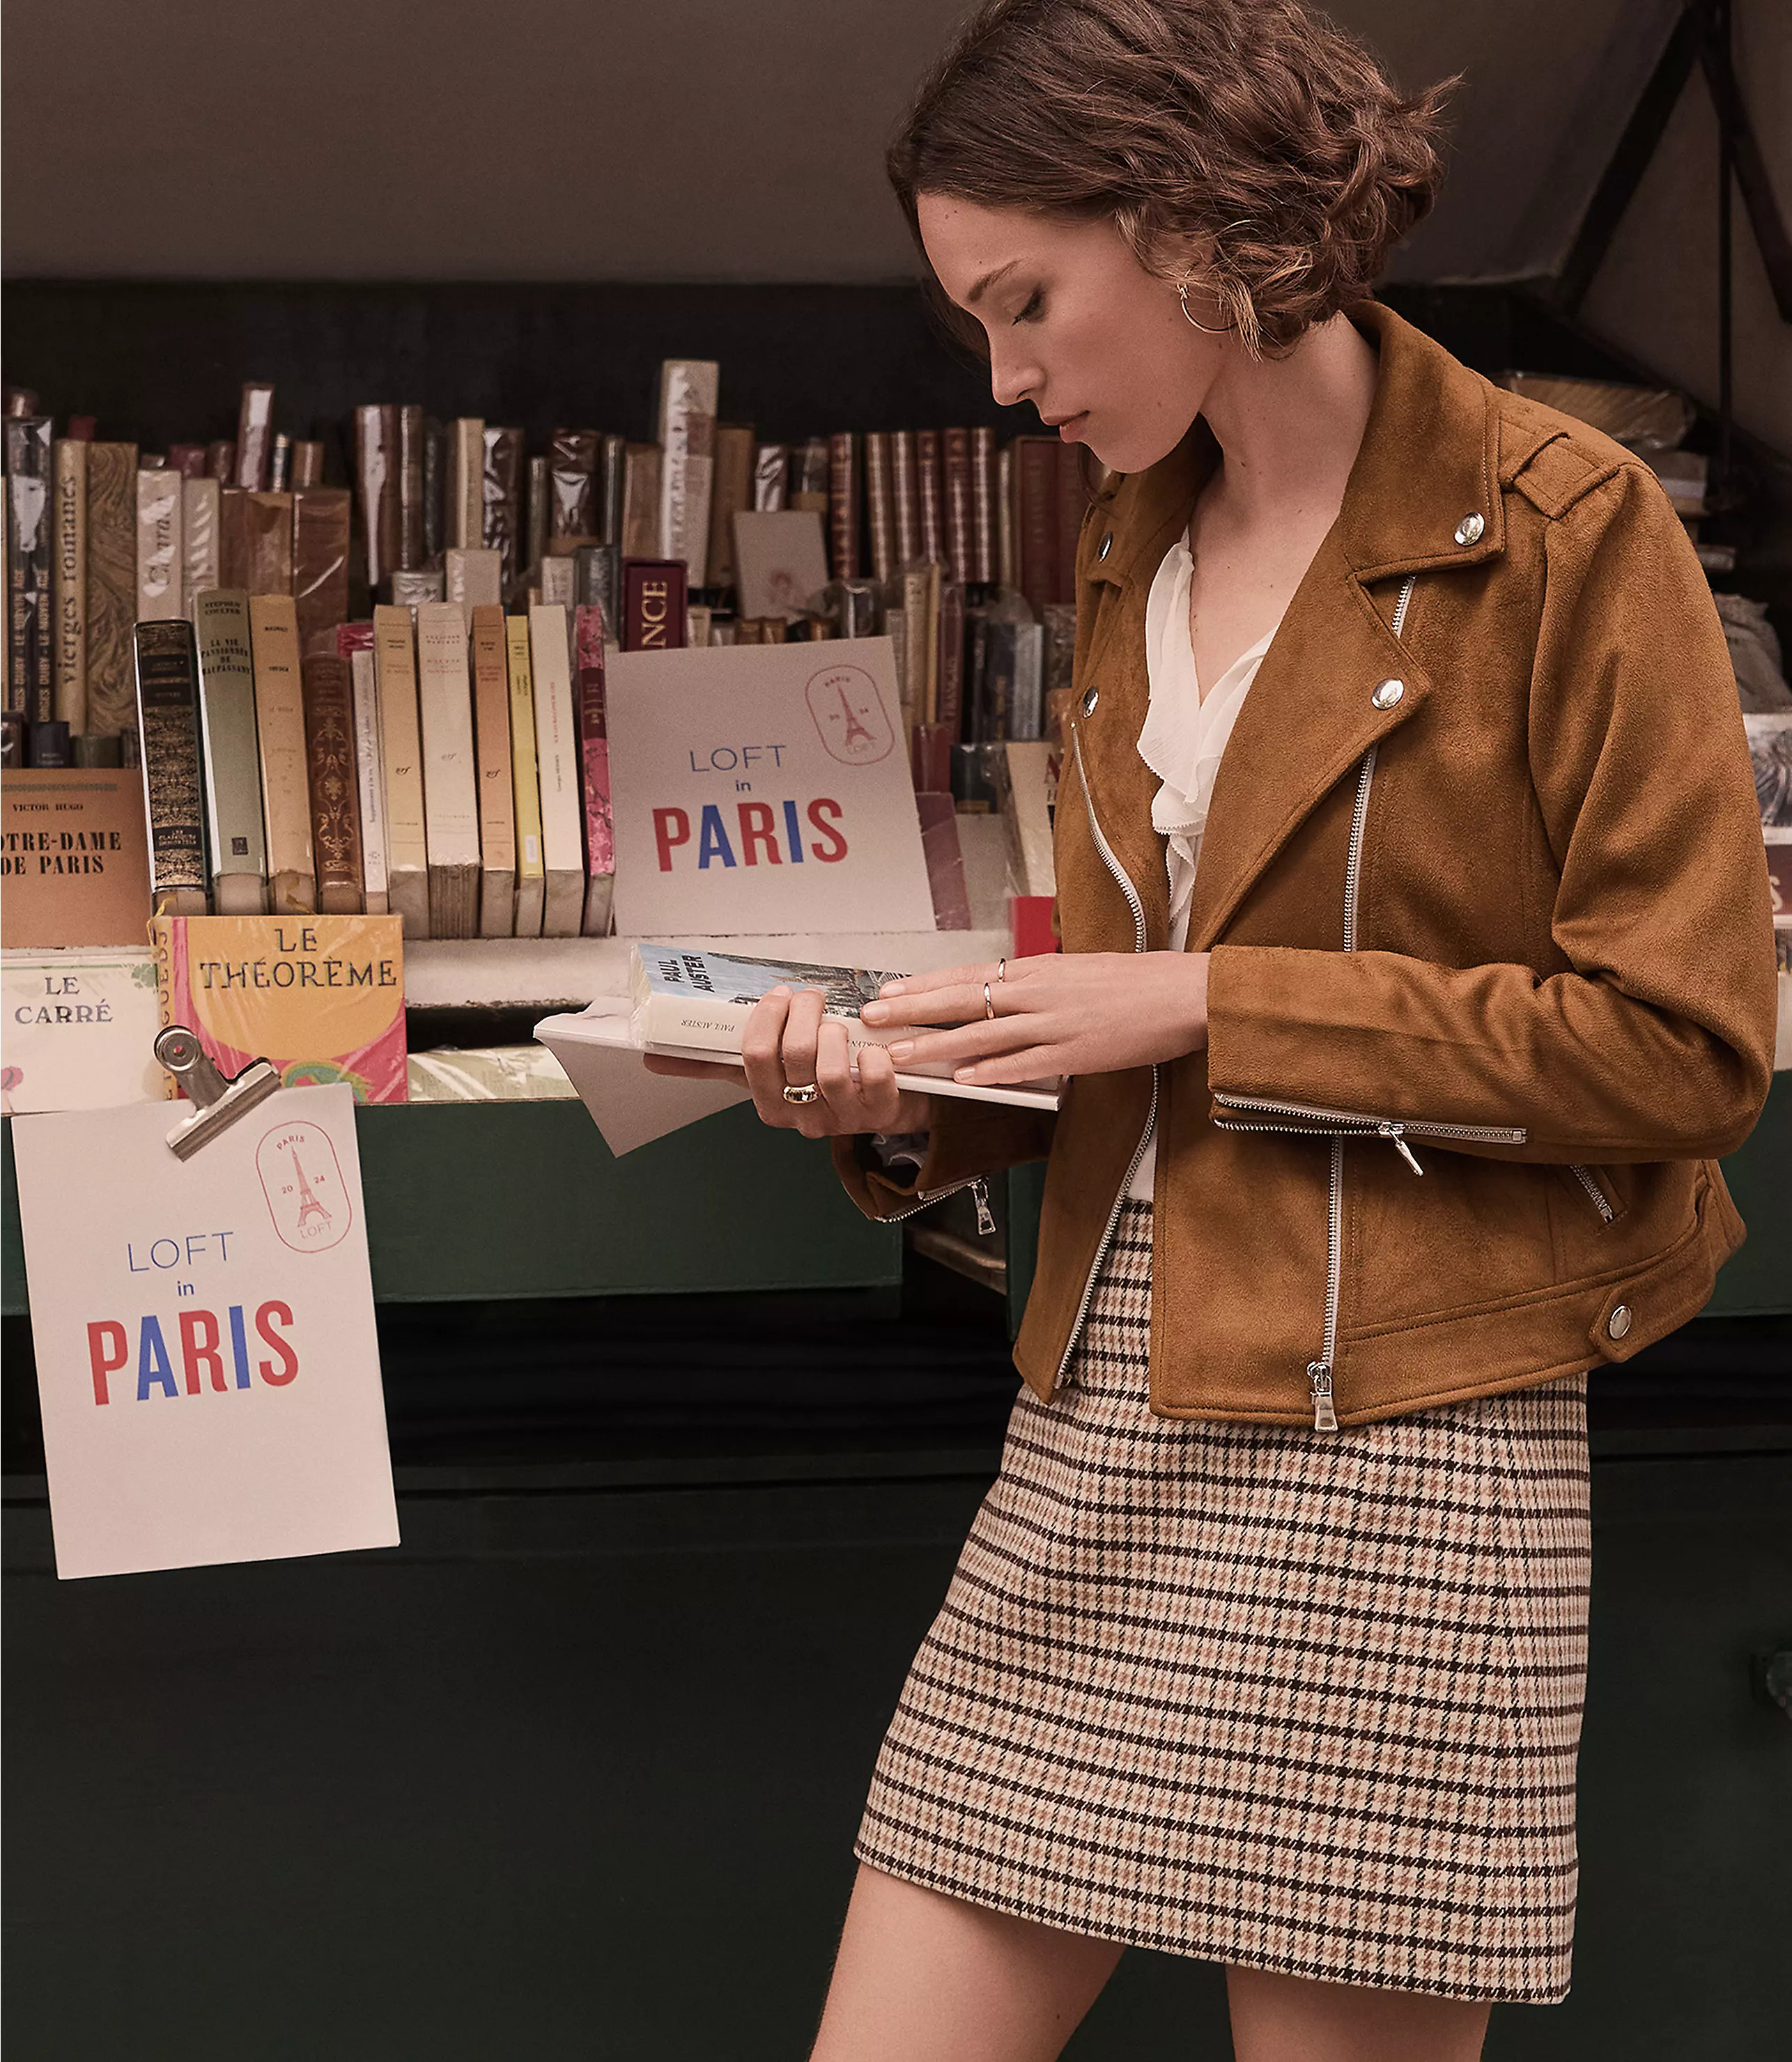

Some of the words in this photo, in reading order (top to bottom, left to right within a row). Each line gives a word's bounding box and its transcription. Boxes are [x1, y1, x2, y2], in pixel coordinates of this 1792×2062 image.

[62, 476, 77, 581] romanes
[57, 597, 82, 683] vierges
[210, 639, 220, 647] LA
[224, 638, 239, 646] VIE
[689, 745, 787, 773] LOFT
[735, 779, 752, 793] in
[13, 803, 49, 812] VICTOR
[55, 803, 84, 812] HUGO
[1, 832, 122, 851] TRE-DAME
[652, 798, 849, 872] PARIS
[1, 856, 26, 876] DE
[40, 855, 105, 874] PARIS
[275, 928, 318, 952] LE
[199, 956, 398, 989] THÉORÈME
[658, 959, 685, 983] PAUL
[681, 954, 715, 993] AUSTER
[45, 976, 81, 995] LE
[15, 998, 114, 1025] CARRÉ
[681, 1019, 713, 1029] AUSTER
[714, 1023, 736, 1032] PAUL
[276, 1135, 304, 1151] PARIS
[281, 1184, 293, 1194] 20
[314, 1175, 325, 1184] 24
[300, 1220, 332, 1239] LOFT
[127, 1231, 234, 1272] LOFT
[177, 1280, 195, 1296] in
[86, 1299, 299, 1406] PARIS
